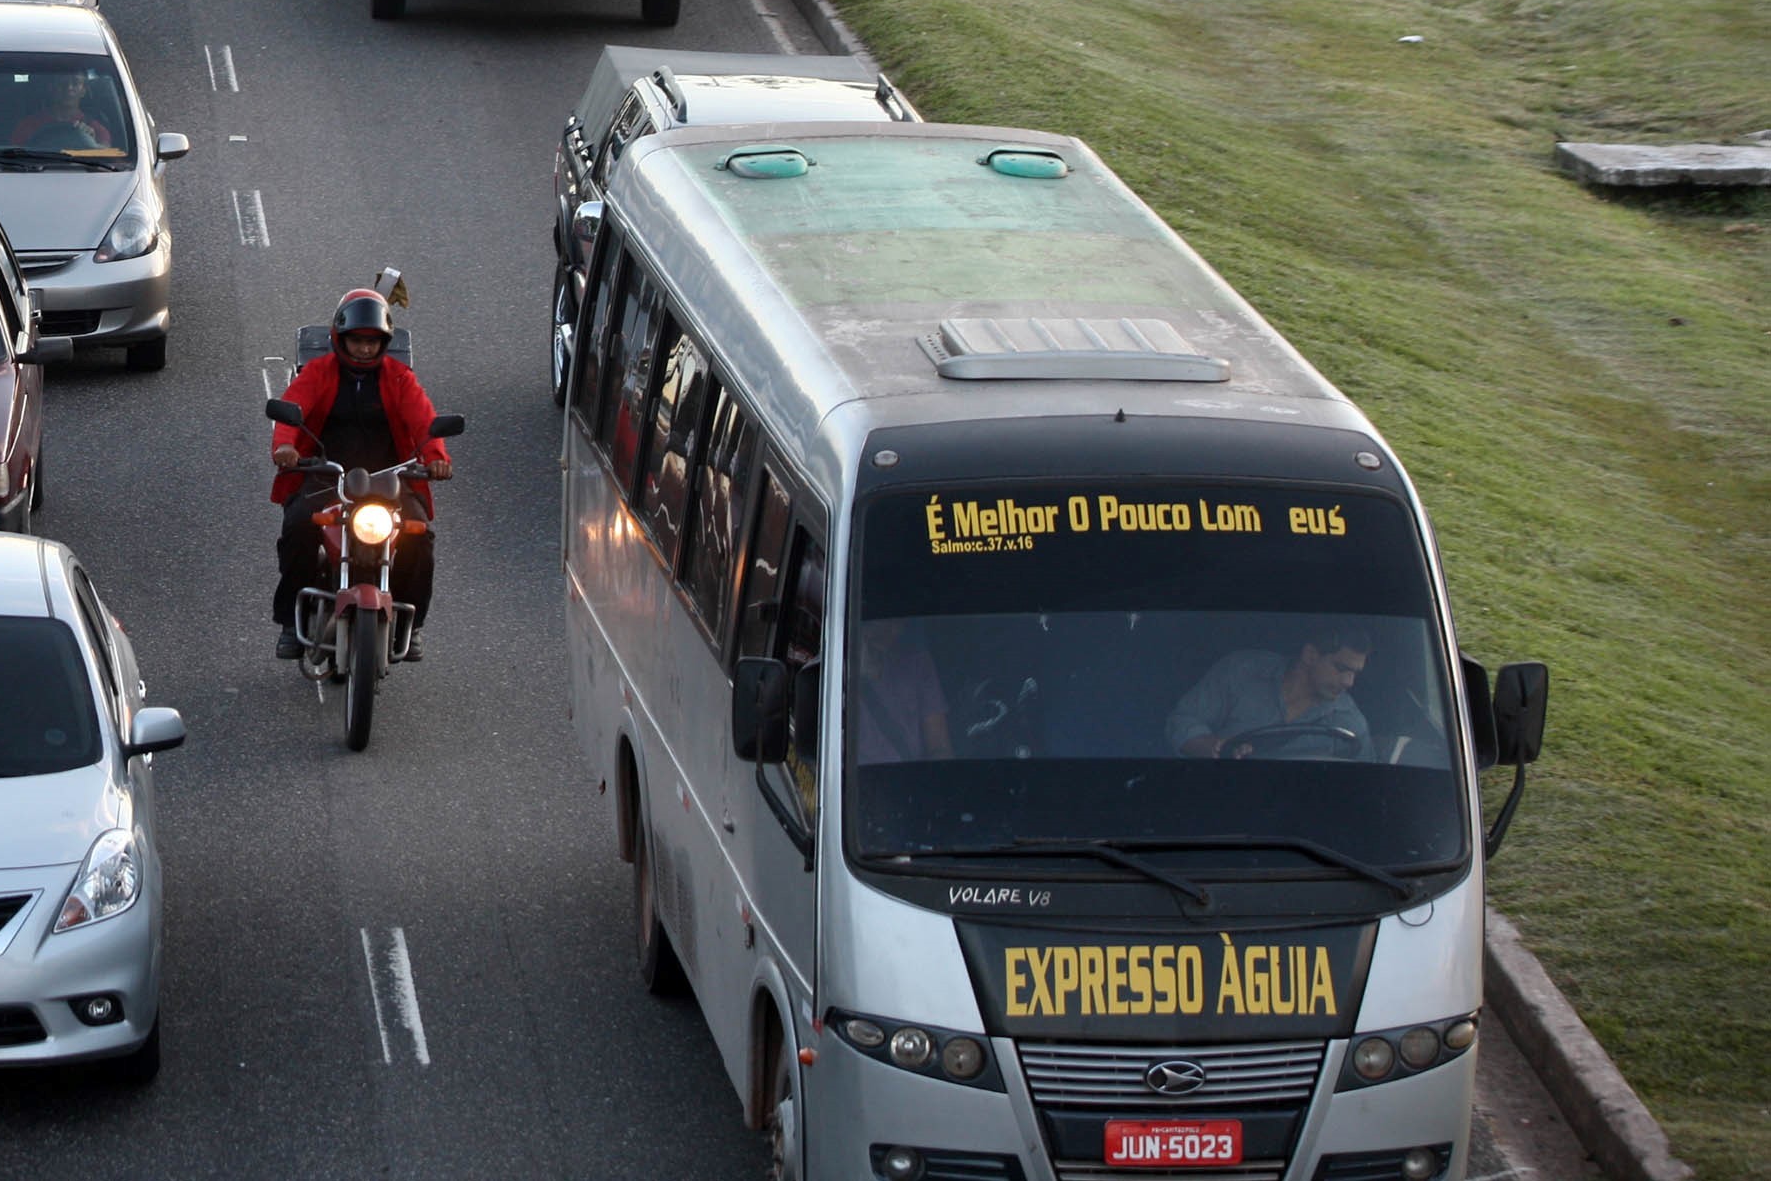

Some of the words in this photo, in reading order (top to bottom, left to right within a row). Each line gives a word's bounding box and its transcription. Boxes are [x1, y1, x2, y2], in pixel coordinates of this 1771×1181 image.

[925, 494, 946, 540] É
[952, 499, 1058, 538] Melhor
[1068, 496, 1090, 533] O
[1099, 495, 1191, 532] Pouco
[930, 536, 1034, 555] Salmo:c.37.v.16
[948, 887, 1022, 906] VOLARE
[1027, 890, 1052, 907] V8
[1004, 944, 1205, 1017] EXPRESSO
